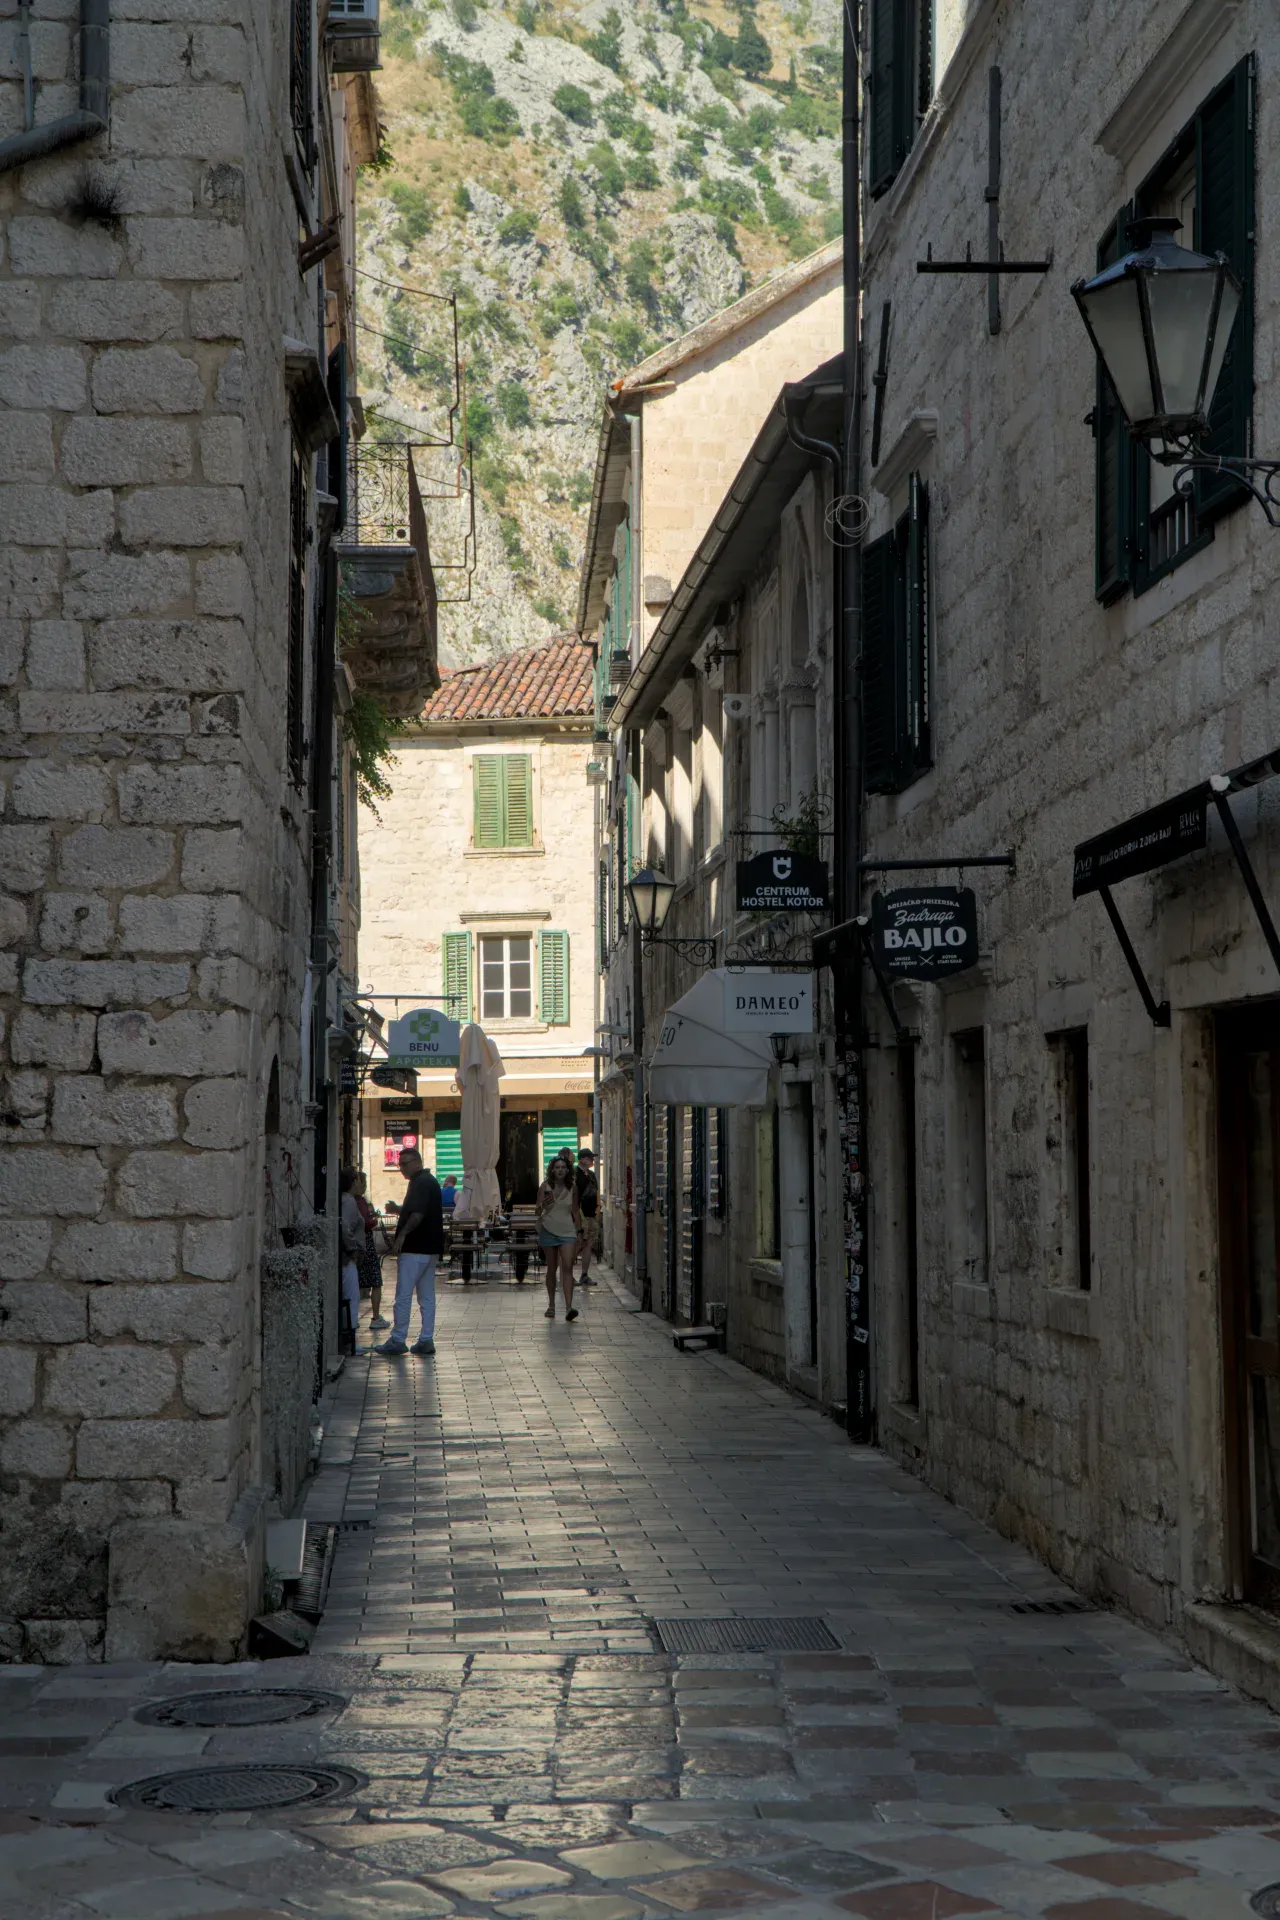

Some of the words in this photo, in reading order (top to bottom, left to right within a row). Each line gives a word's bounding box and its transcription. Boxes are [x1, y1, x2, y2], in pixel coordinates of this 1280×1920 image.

[755, 886, 810, 896] CENTRUM
[741, 897, 785, 907] HOSTEL
[786, 897, 824, 907] KOTOR
[893, 908, 956, 927] Zadruga
[883, 926, 967, 952] BAJLO
[735, 996, 799, 1010] DAMEO
[409, 1042, 440, 1052] BENU
[396, 1056, 452, 1067] APOTEKA
